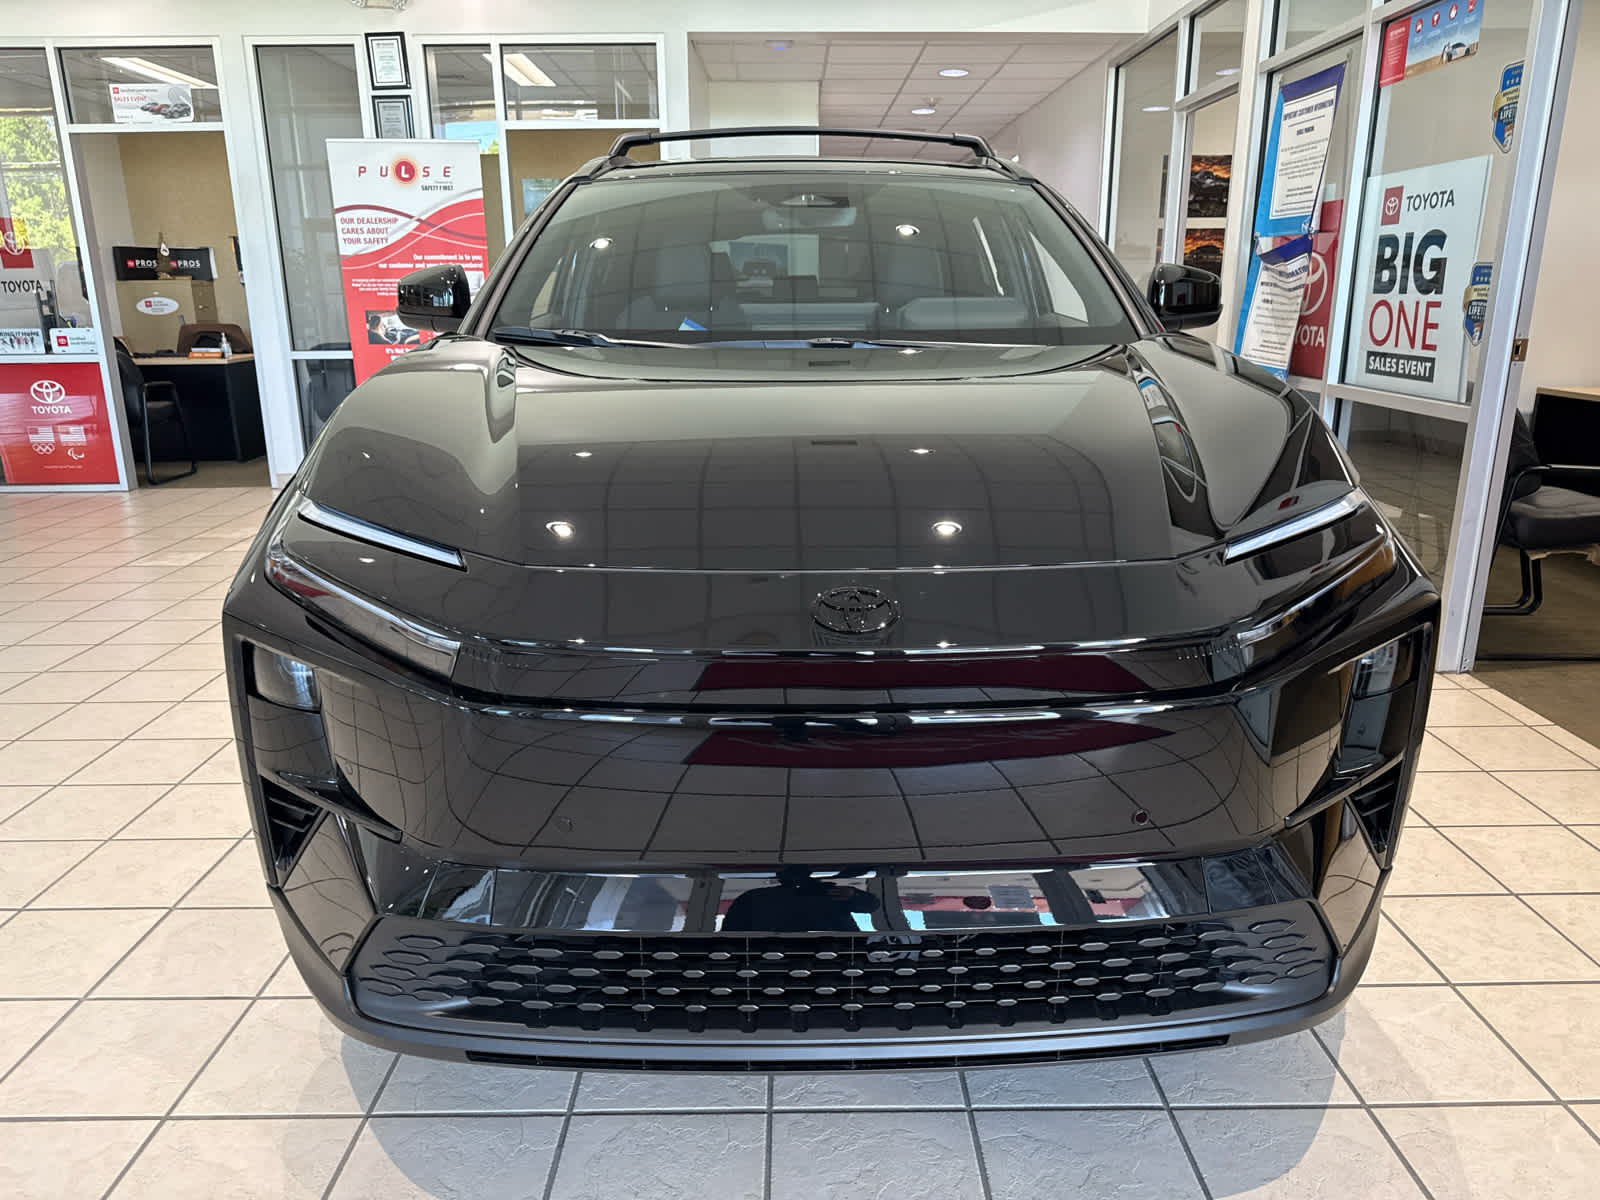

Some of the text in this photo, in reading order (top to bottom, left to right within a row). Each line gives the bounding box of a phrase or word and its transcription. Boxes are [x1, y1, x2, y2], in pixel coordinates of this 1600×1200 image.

[358, 164, 451, 179] PULSE
[1406, 189, 1455, 212] TOYOTA
[340, 216, 399, 224] OUR DEALERSHIP
[341, 227, 389, 235] CARES ABOUT
[343, 237, 389, 245] YOUR SAFETY
[136, 259, 201, 268] PROS PROS
[1372, 229, 1448, 295] BIG
[1, 280, 44, 294] TOYOTA
[1368, 299, 1442, 351] ONE
[1295, 326, 1325, 347] YOTA
[1368, 355, 1432, 377] SALES EVENT
[31, 405, 72, 415] TOYOTA
